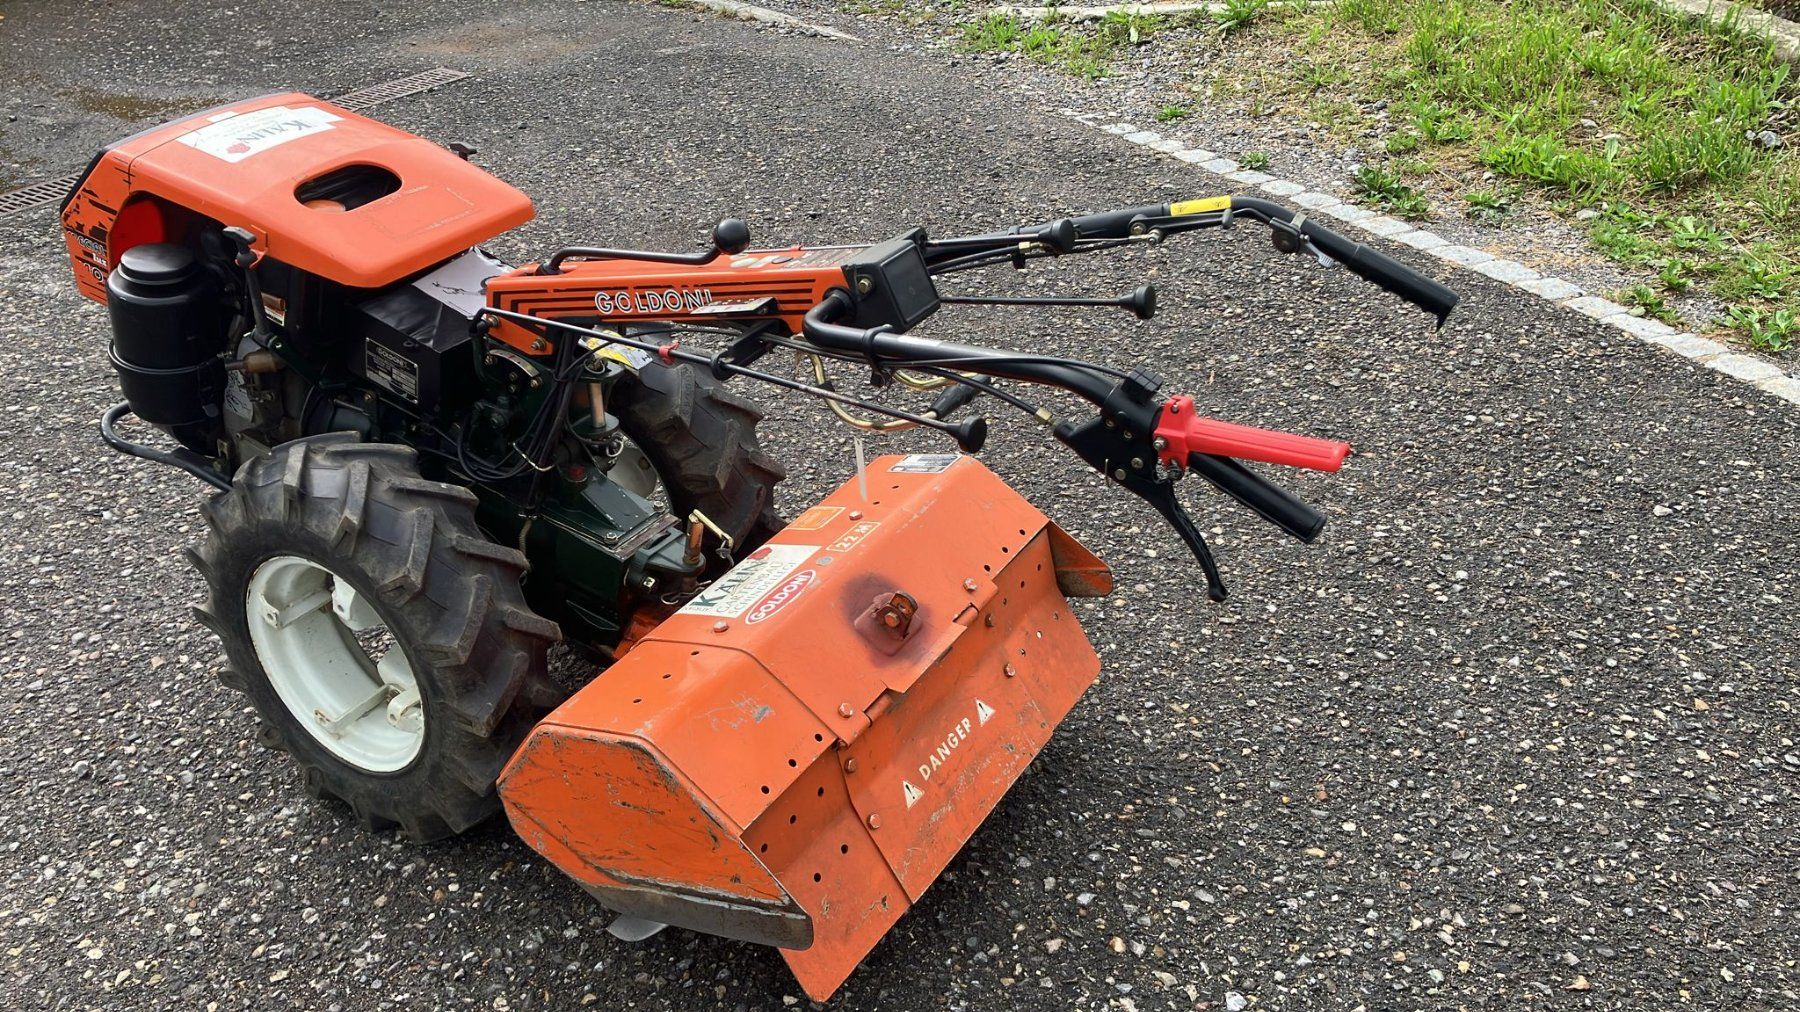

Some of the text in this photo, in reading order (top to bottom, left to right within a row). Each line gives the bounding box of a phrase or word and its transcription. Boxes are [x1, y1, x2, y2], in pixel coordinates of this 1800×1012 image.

[595, 289, 713, 315] GOLDONI
[750, 572, 812, 621] GOLDONI
[919, 717, 971, 781] DANGER
